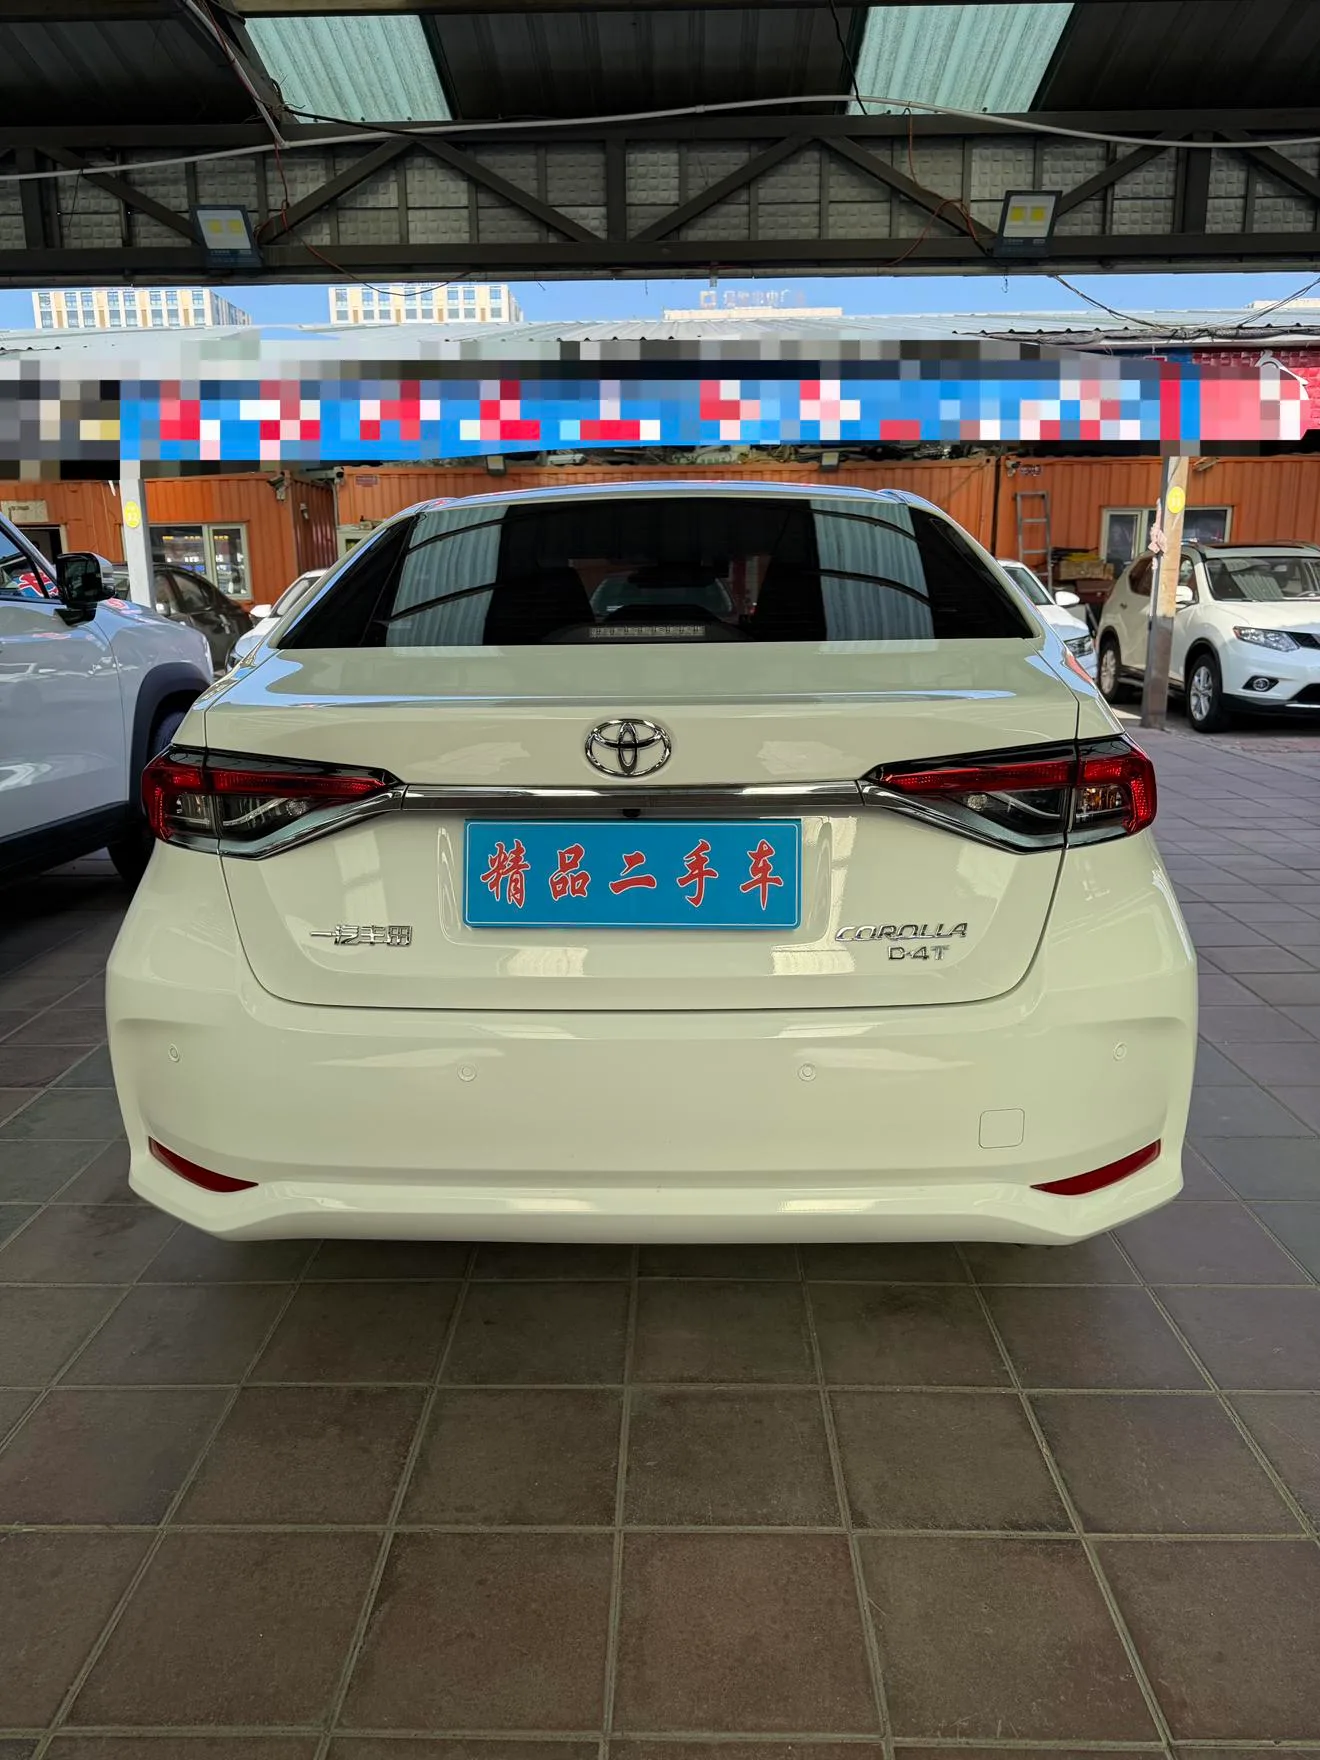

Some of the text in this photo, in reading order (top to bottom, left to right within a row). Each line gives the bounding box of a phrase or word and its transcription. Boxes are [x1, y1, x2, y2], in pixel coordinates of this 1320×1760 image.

[480, 838, 784, 911] 精品二手车
[310, 925, 413, 946] 一汽丰田
[835, 922, 968, 941] COROLLA
